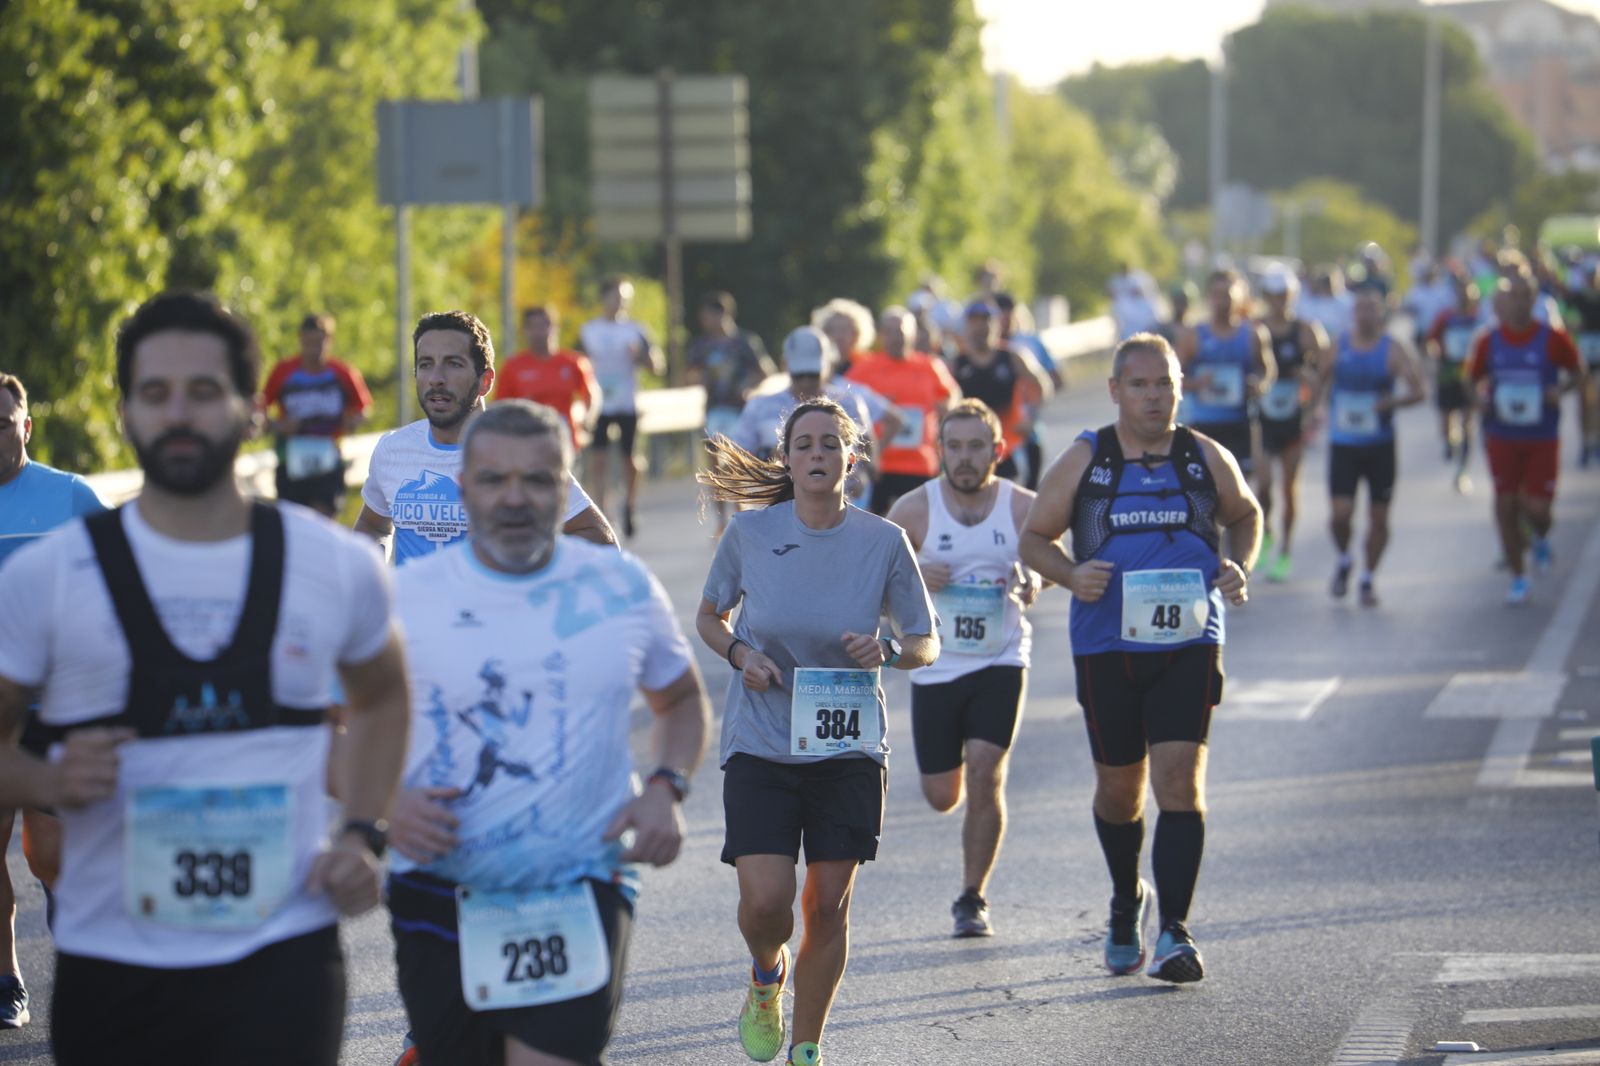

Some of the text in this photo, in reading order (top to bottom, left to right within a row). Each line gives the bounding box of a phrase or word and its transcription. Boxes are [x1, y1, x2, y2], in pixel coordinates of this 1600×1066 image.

[393, 503, 466, 521] PICO VELE
[1109, 511, 1187, 527] TROTASIER
[993, 529, 1006, 545] h
[1127, 583, 1158, 593] MEDIA
[1151, 604, 1182, 630] 48
[954, 615, 986, 641] 135
[798, 683, 876, 696] MEDIA MARATÓN
[815, 708, 861, 740] 384
[503, 934, 569, 983] 238
